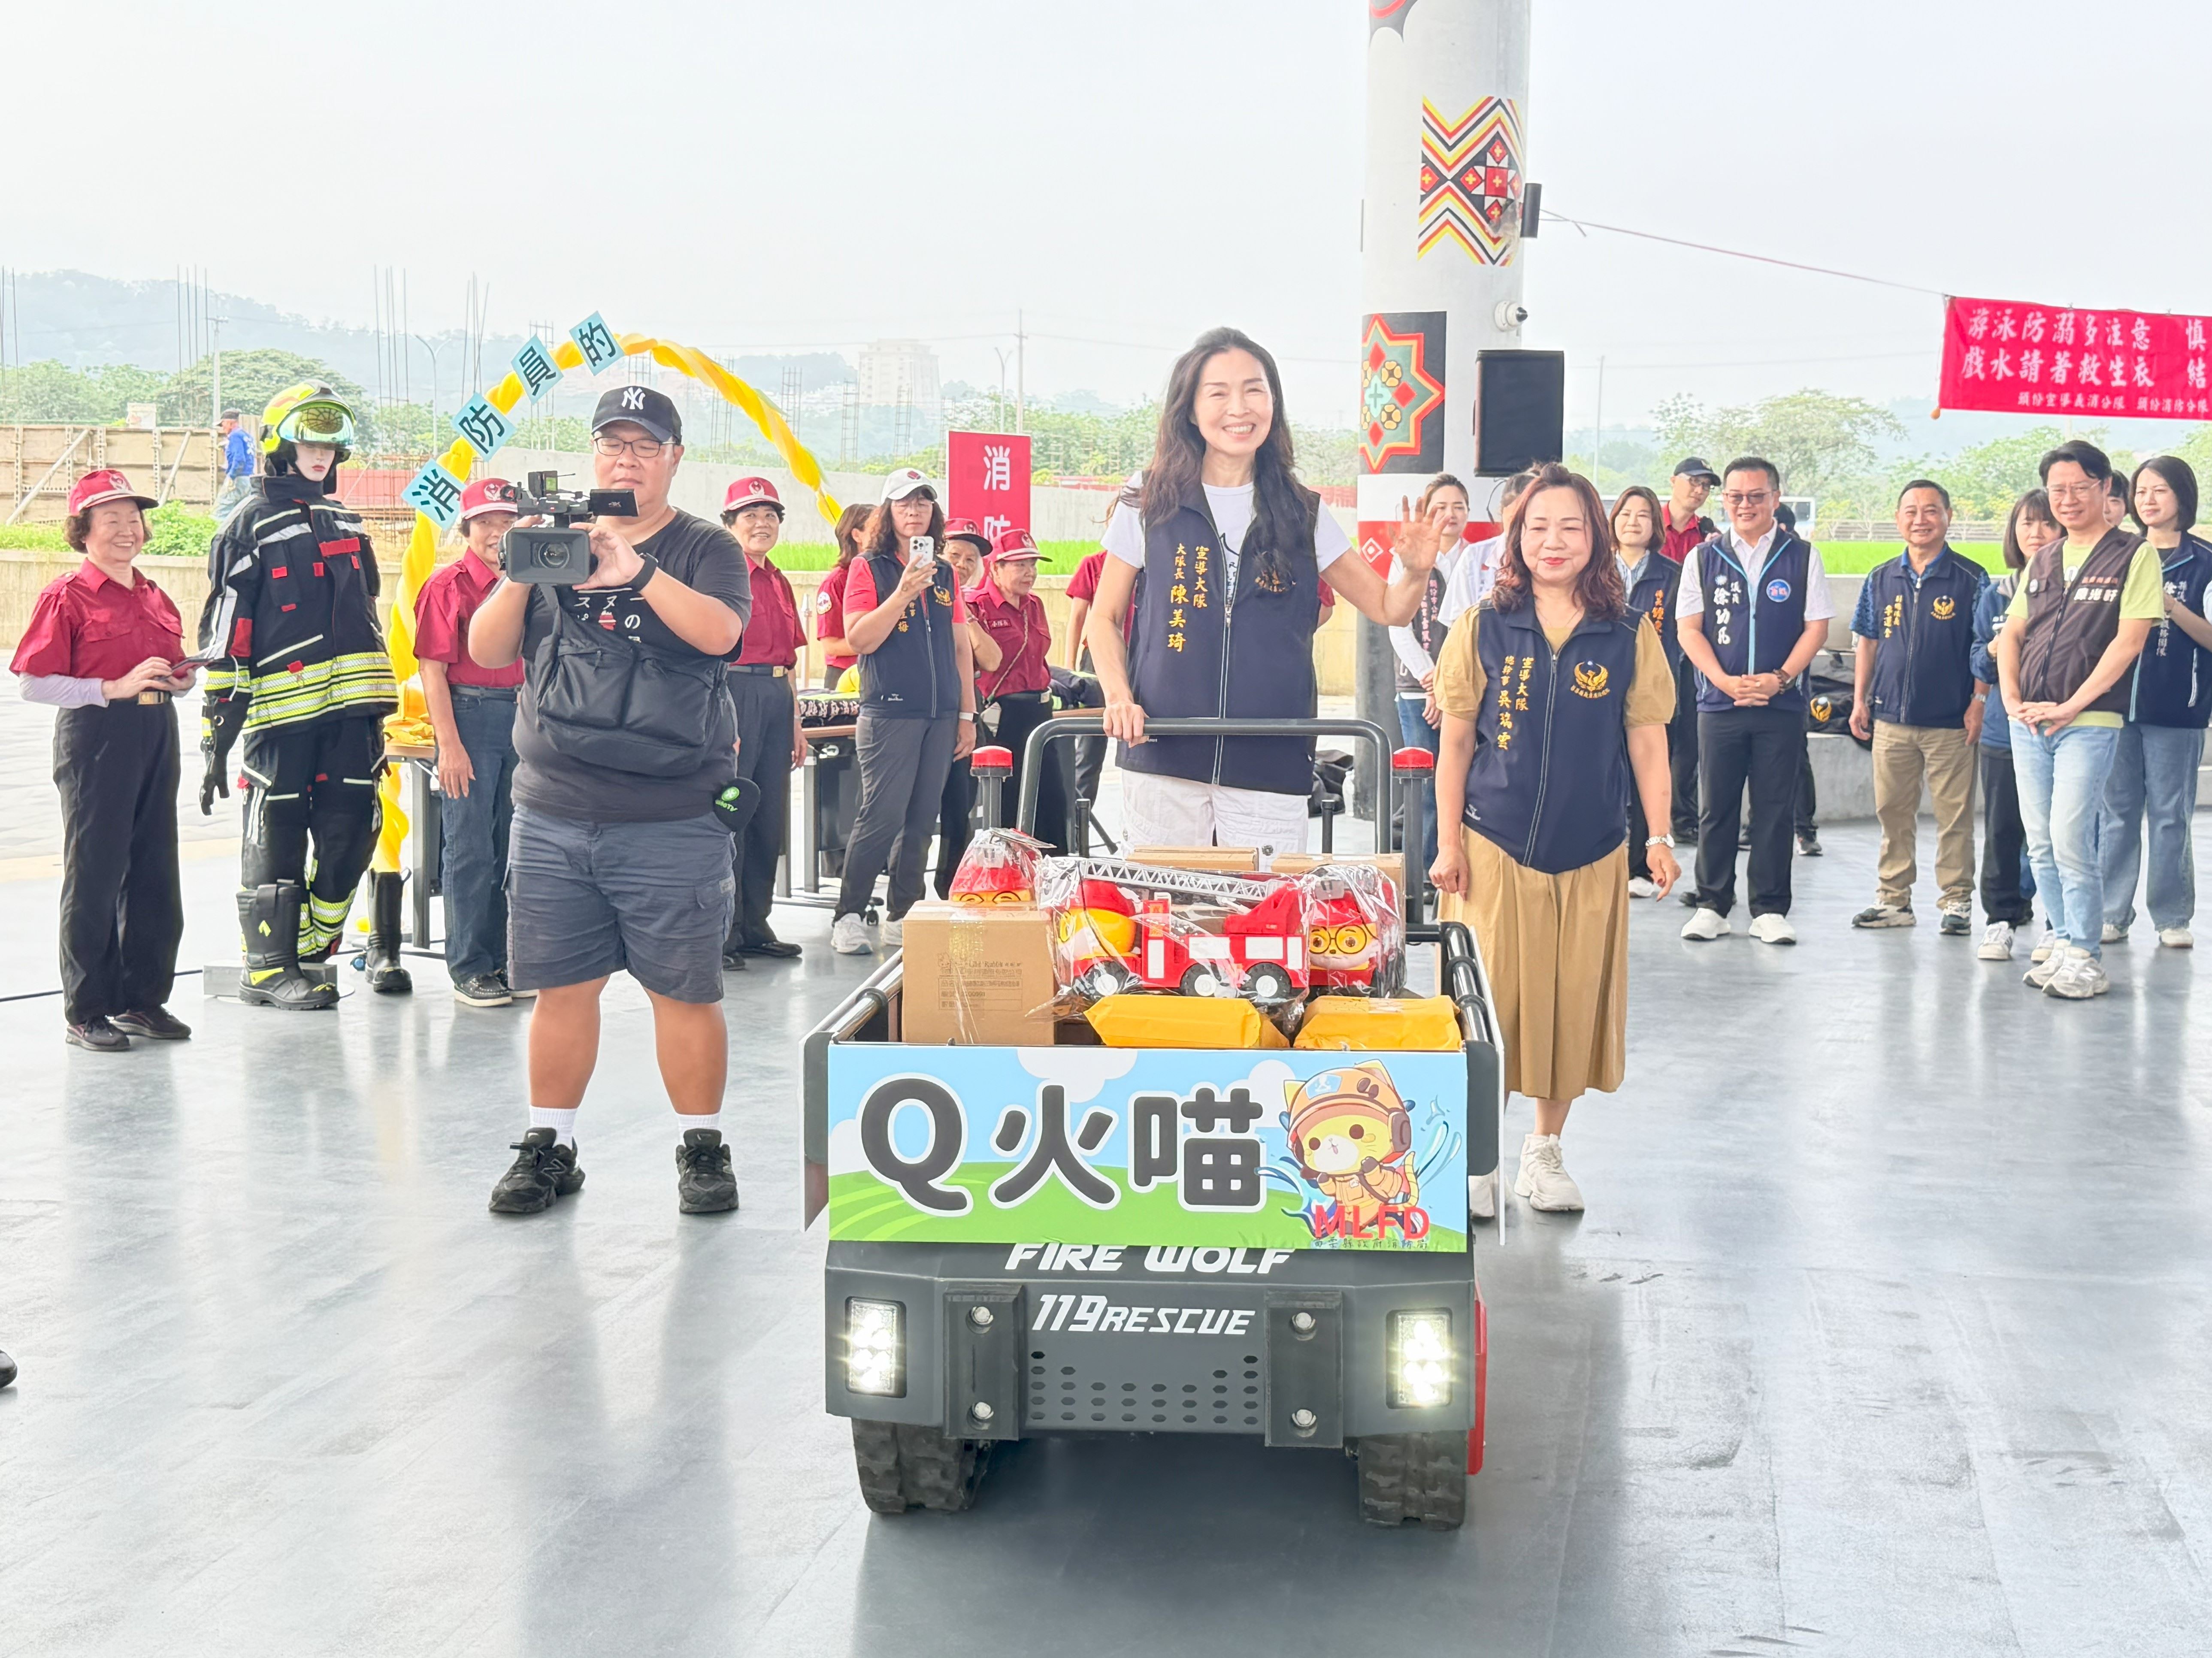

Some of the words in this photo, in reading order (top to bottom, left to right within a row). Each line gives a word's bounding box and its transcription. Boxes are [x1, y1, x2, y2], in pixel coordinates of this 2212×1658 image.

[1968, 307, 2151, 351] 游泳防溺多注意
[1193, 545, 1210, 608] 宣導大隊
[861, 1077, 1263, 1211] Q火喵
[1315, 1204, 1431, 1240] MLFD
[1005, 1243, 1129, 1271] FIRE
[1144, 1245, 1295, 1274] WOLF
